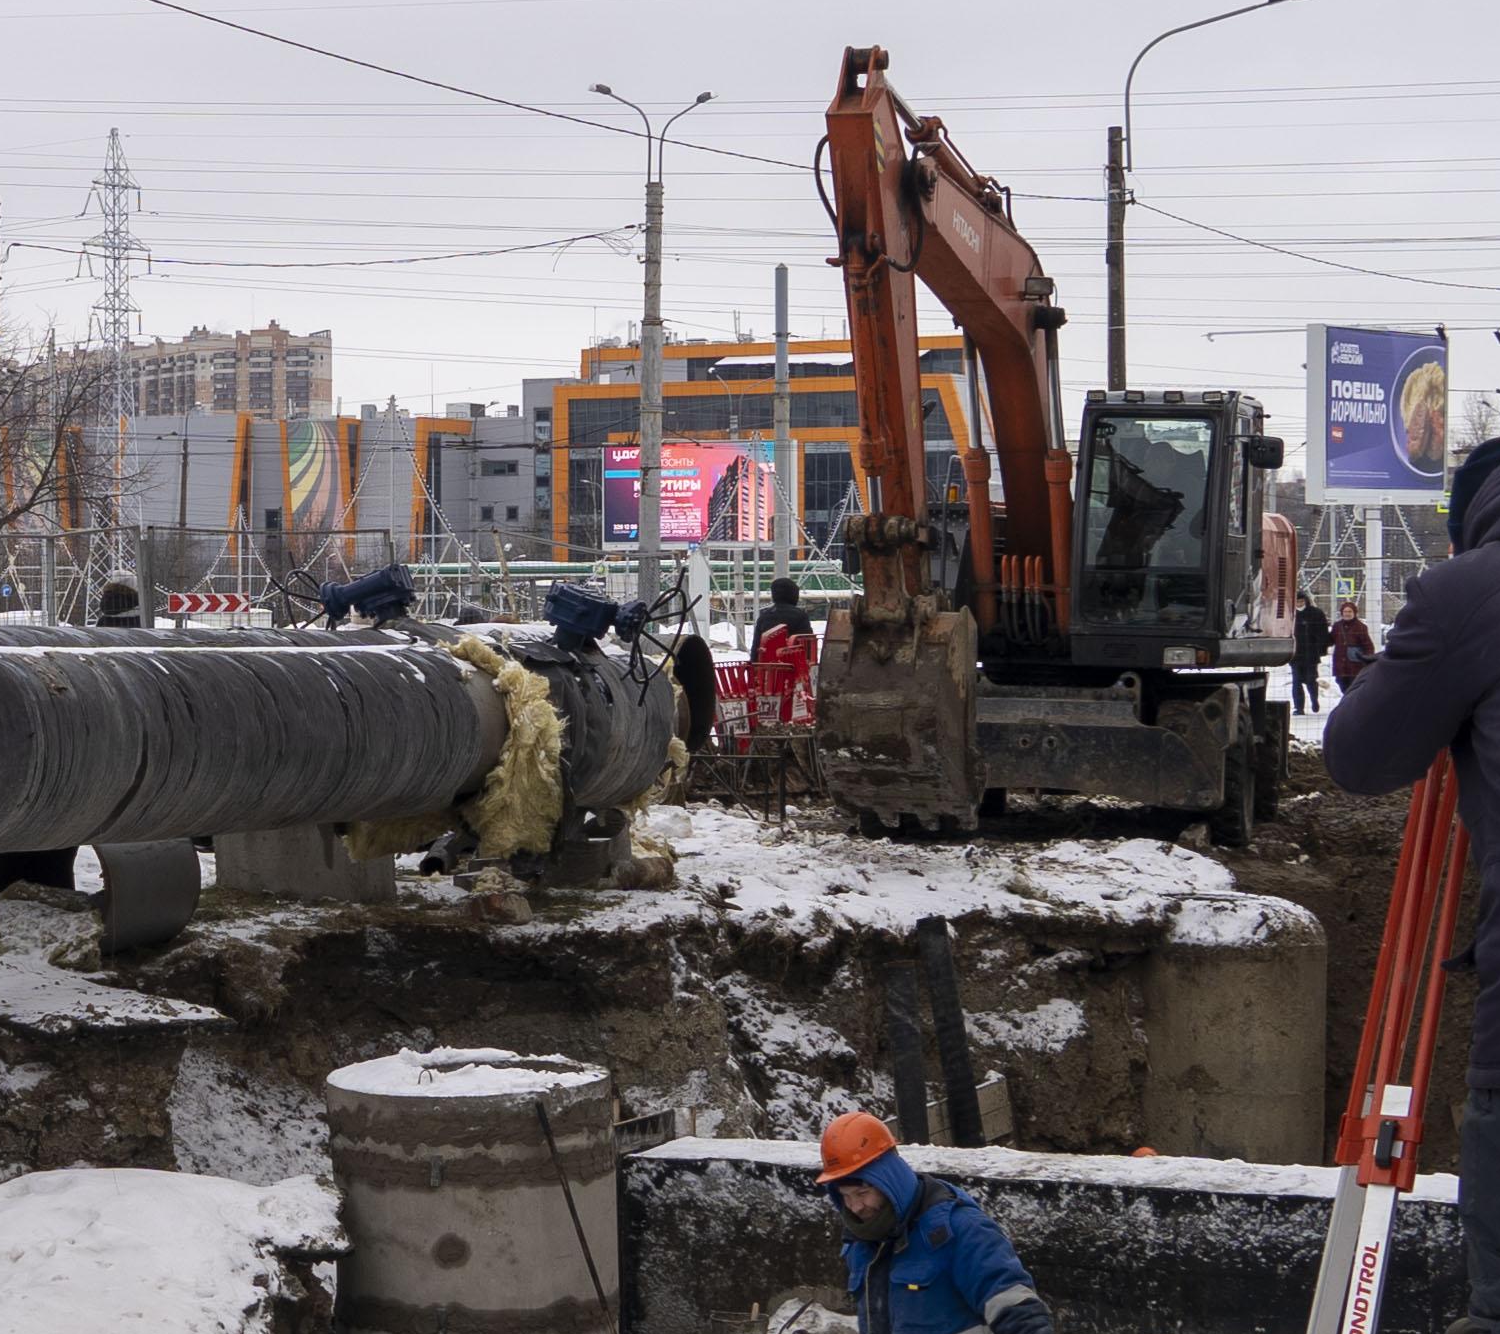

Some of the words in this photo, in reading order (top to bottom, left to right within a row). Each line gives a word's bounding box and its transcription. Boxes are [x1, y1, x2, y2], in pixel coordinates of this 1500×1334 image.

[952, 209, 980, 254] HITACHI
[1331, 380, 1385, 401] ПОЕШЬ
[1331, 401, 1387, 424] НОРМАЛЬНО
